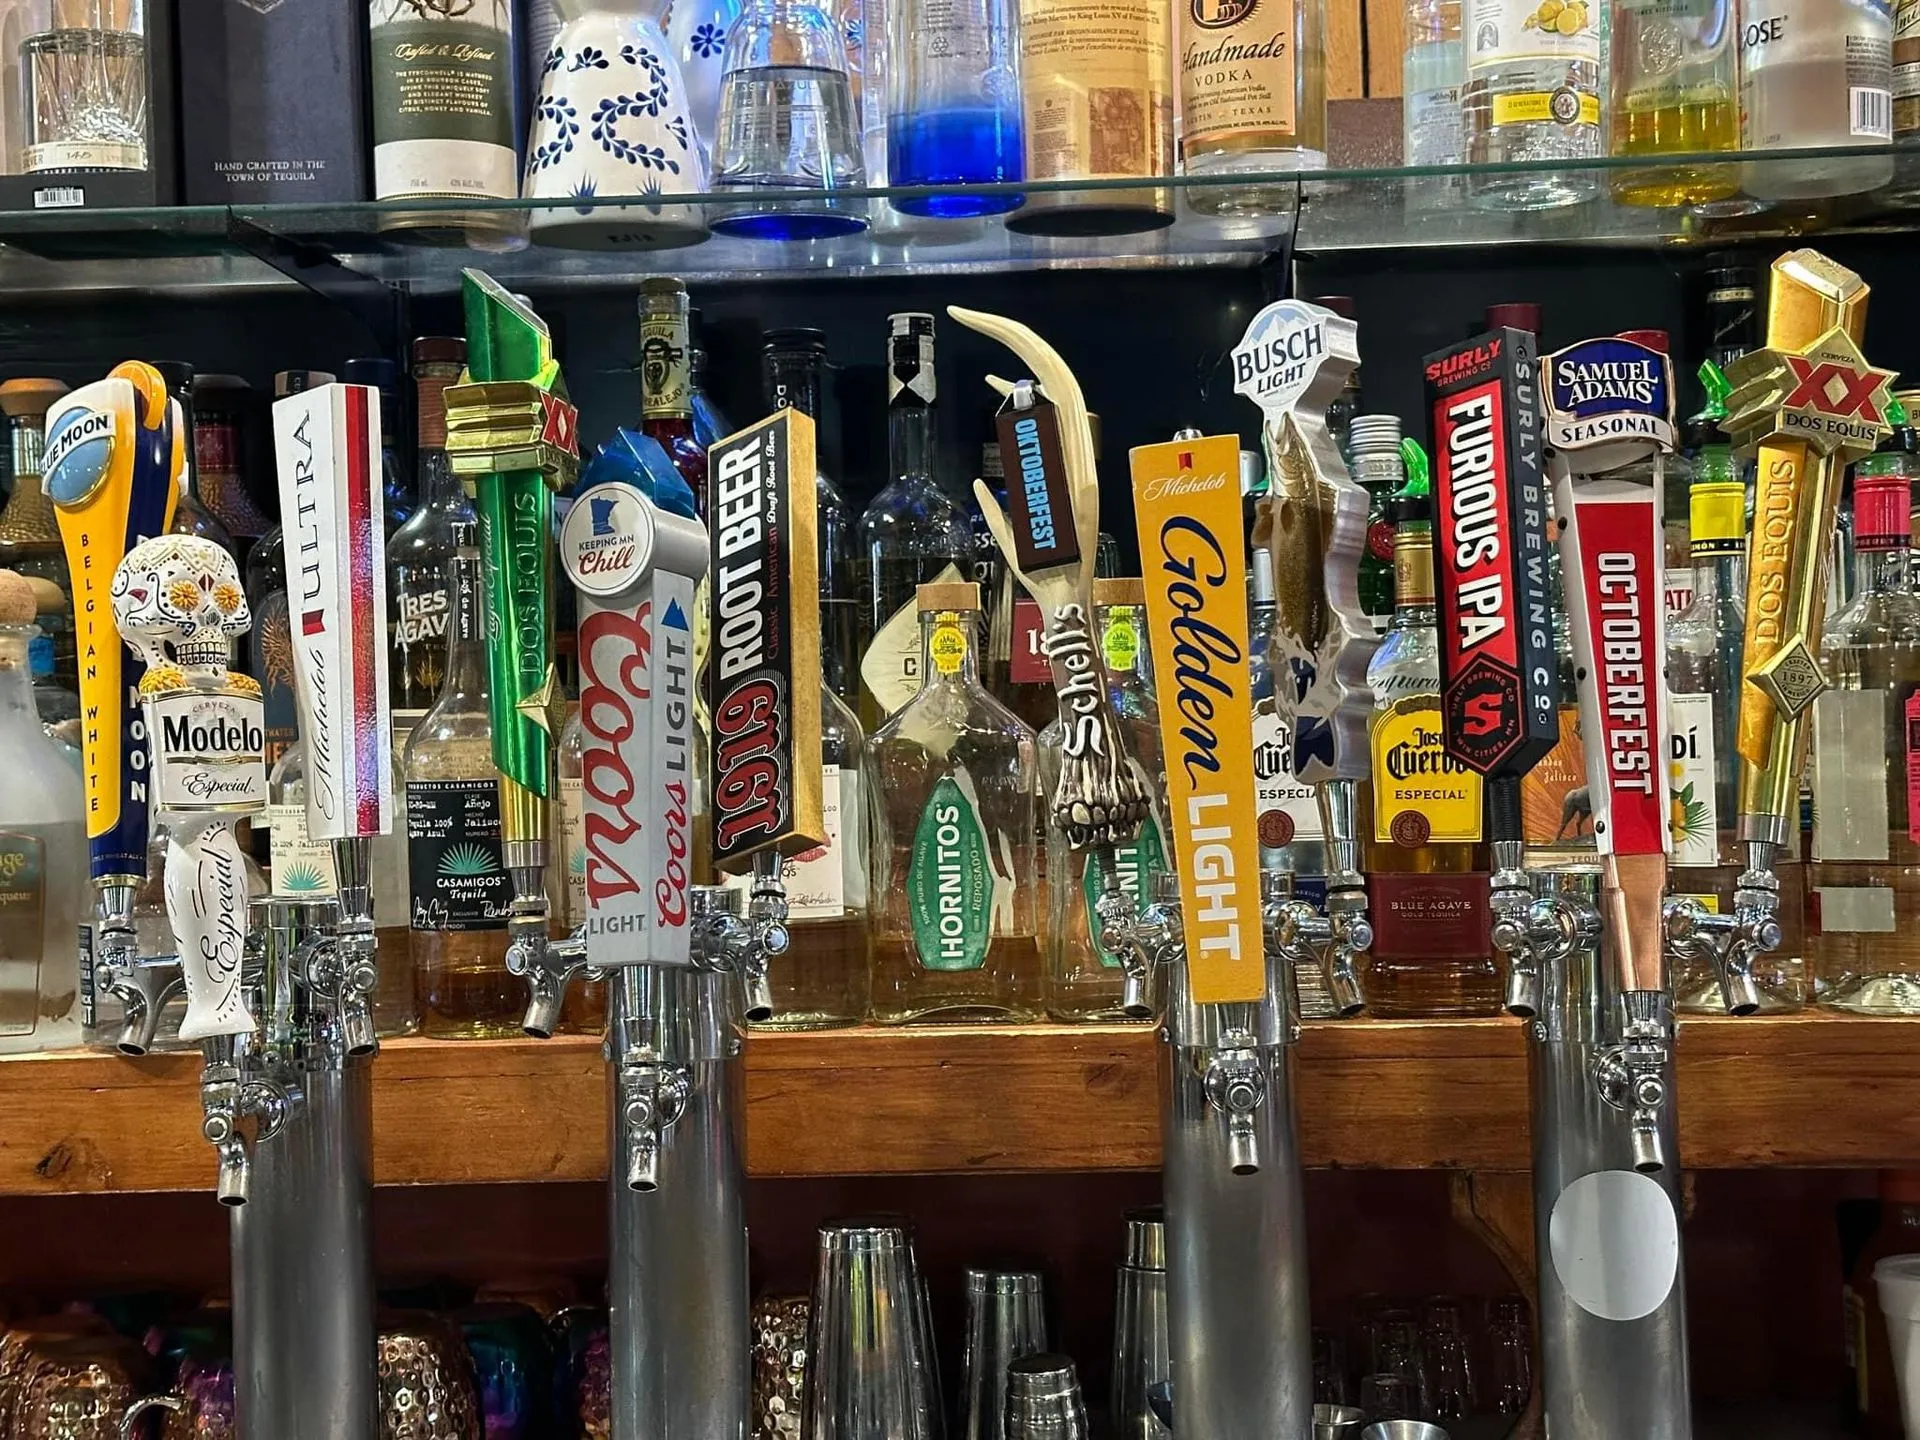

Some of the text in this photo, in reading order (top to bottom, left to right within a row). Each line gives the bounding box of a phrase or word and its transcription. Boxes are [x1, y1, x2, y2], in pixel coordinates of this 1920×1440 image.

[395, 43, 436, 61] Crafted
[451, 43, 495, 61] Refined
[1181, 31, 1285, 75] Handmade
[1195, 69, 1253, 87] VODKA
[1232, 107, 1272, 116] TEXAS
[214, 160, 326, 171] HAND CRAFTED IN THE
[225, 171, 315, 182] TOWN OF TEQUILA
[1236, 323, 1322, 385] BUSCH
[1425, 339, 1502, 381] SURLY
[1820, 350, 1856, 365] CERVEZA
[1257, 363, 1306, 394] LIGHT
[1437, 366, 1478, 387] BREWING
[1558, 360, 1659, 387] SAMUEL
[1567, 381, 1654, 408] ADAMS
[1781, 356, 1888, 424] XX
[61, 414, 110, 452] MOON
[1562, 417, 1660, 443] SEASONAL
[1786, 413, 1876, 442] DOS EQUIS
[765, 430, 776, 458] Beer
[765, 460, 777, 490] Root
[1015, 418, 1056, 551] OKTOBERFEST
[1144, 473, 1226, 502] Michelob
[293, 408, 321, 605] ULTRA
[766, 493, 778, 524] Draft
[1515, 362, 1547, 650] SURLY BREWING
[1449, 393, 1507, 649] FURIOUS IPA
[578, 533, 635, 552] KEEPING MN
[1754, 458, 1796, 645] DOS EQUIS
[578, 544, 636, 576] Chill
[719, 436, 763, 681] ROOT BEER
[514, 492, 543, 675] DOS EQUIS
[396, 588, 447, 618] TRES
[80, 533, 99, 812] BELGIAN WHITE
[1466, 671, 1506, 687] BREWING
[1597, 552, 1653, 796] OCTOBERFEST
[1781, 671, 1814, 685] 1897
[191, 700, 238, 714] CERVEZA
[162, 715, 263, 753] Modelo
[308, 646, 336, 822] Michelob
[1160, 515, 1241, 961] Golden LIGHT
[715, 676, 781, 851] 1919
[181, 772, 256, 800] Especial.
[444, 782, 494, 790] CASAMIGOS
[655, 635, 690, 930] Coors LIGHT
[1259, 788, 1317, 800] ESPECIA
[1395, 789, 1465, 801] ESPECIAL
[464, 798, 490, 810] Añejo
[426, 828, 446, 838] Azul
[434, 816, 453, 829] 100%
[1570, 855, 1600, 864] TEQU
[436, 876, 501, 889] CASAMIGOS
[450, 888, 487, 902] Tequila
[935, 805, 964, 958] HORNITOS
[970, 849, 983, 912] REPOSADO
[1391, 901, 1472, 910] BLUE AGAVE
[589, 912, 648, 936] LIGHT
